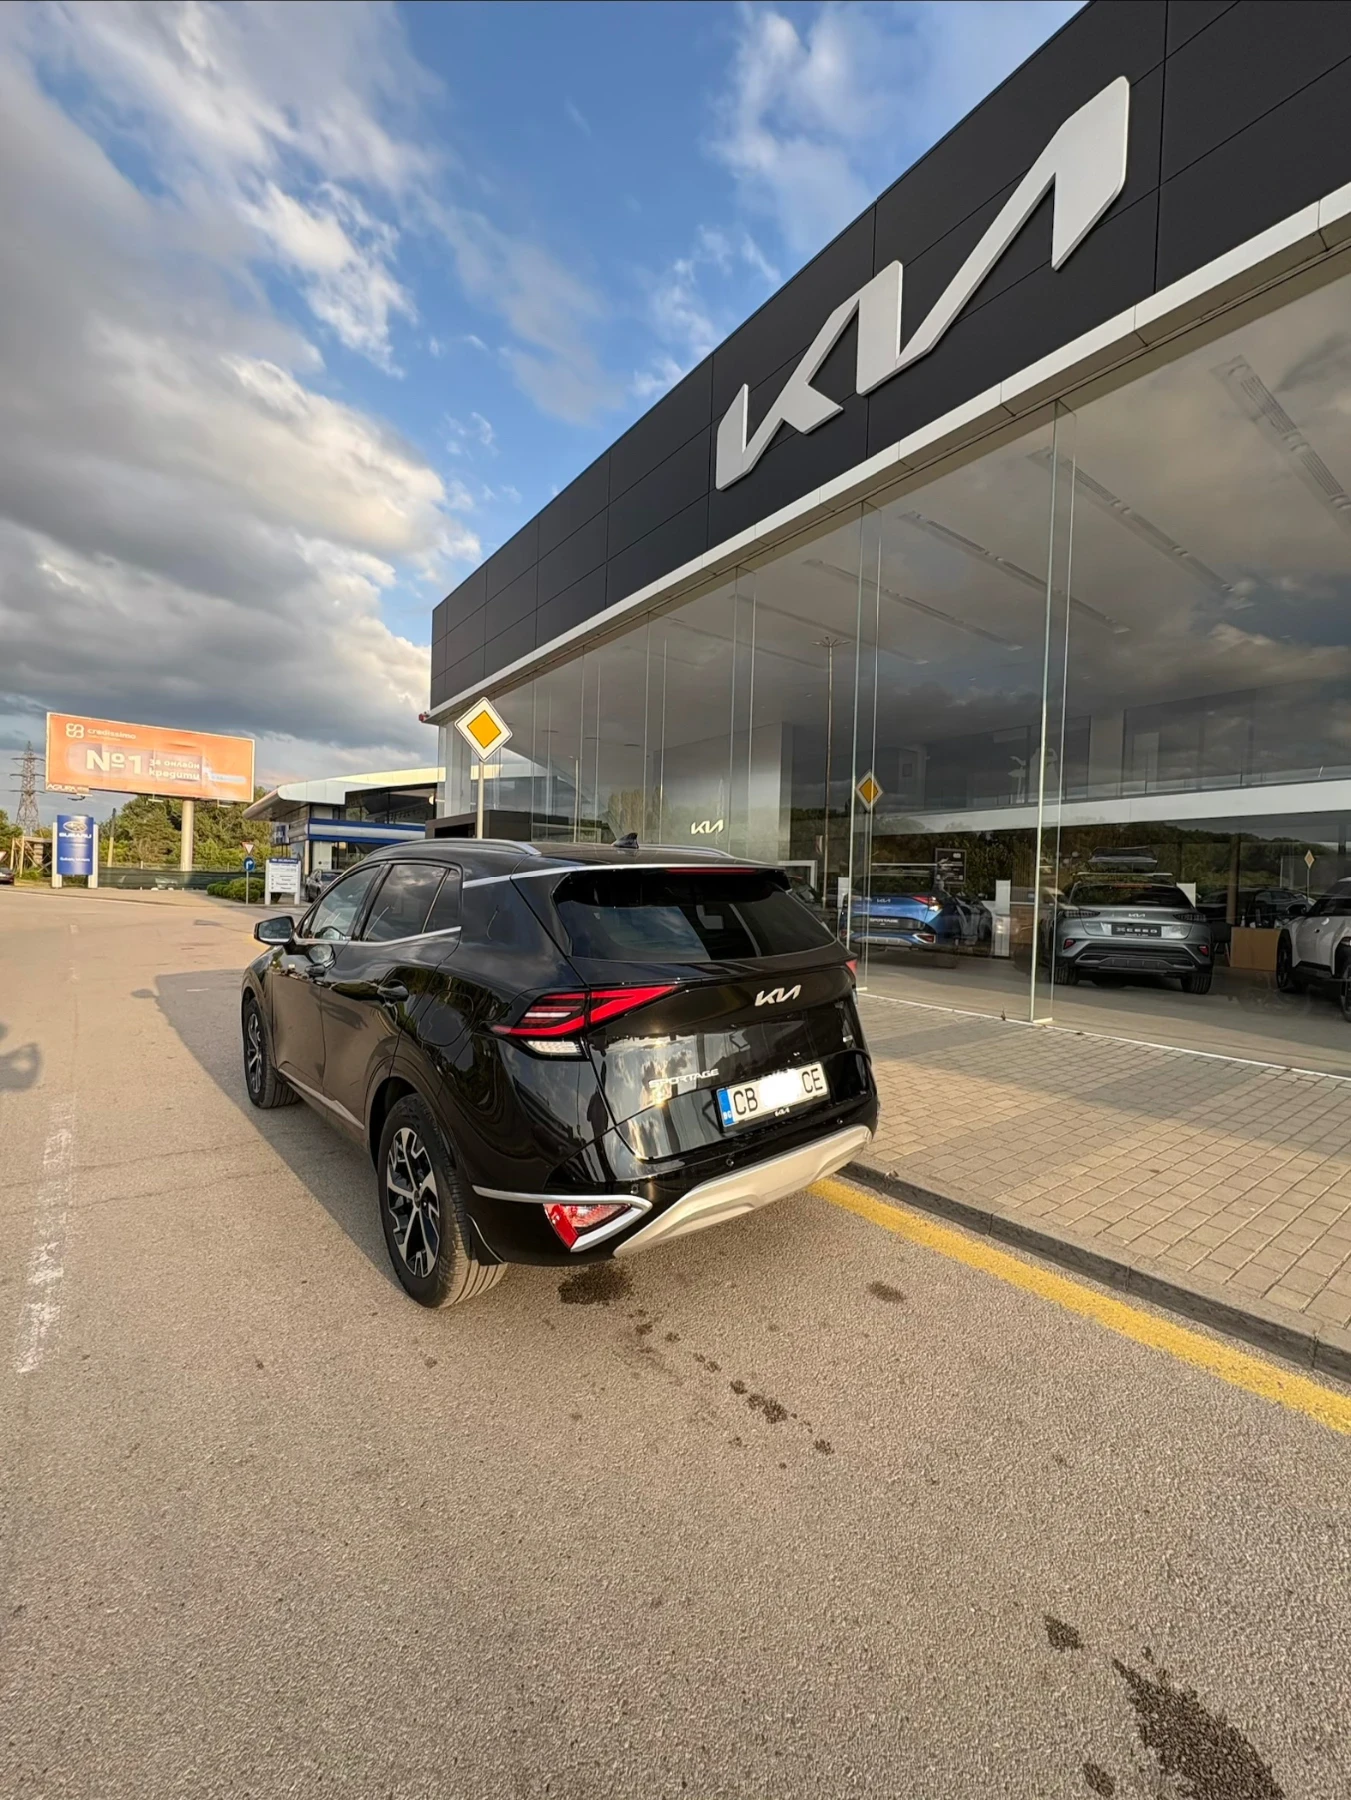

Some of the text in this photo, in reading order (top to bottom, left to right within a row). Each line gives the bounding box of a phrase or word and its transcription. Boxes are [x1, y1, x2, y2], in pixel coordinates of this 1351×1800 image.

[715, 75, 1131, 491] KIA
[87, 728, 137, 740] credissimo
[164, 761, 200, 769] онлайн
[149, 767, 200, 780] кредити
[691, 819, 723, 834] KIA
[754, 984, 802, 1007] KIA
[648, 1069, 719, 1088] SPORTAGE
